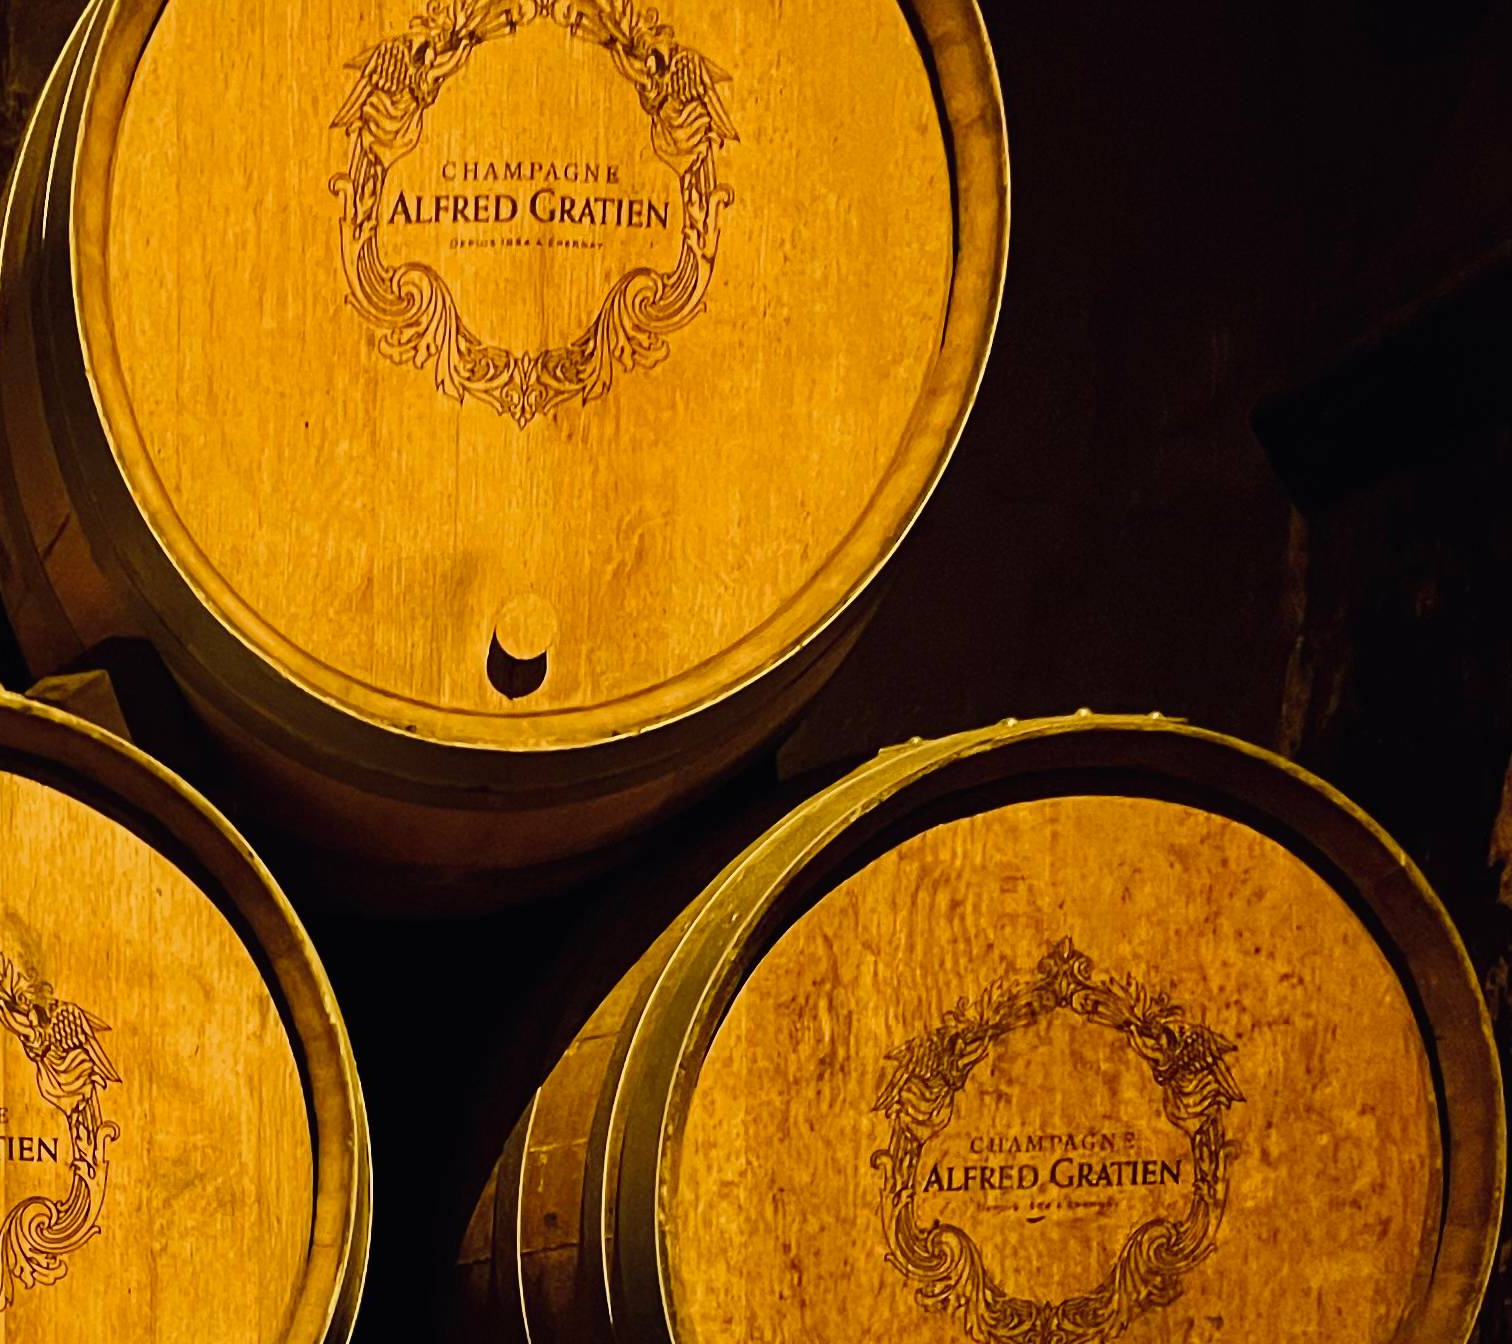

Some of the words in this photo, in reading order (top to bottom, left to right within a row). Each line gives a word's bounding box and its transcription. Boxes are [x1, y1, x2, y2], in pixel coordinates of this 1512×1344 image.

[441, 160, 621, 184] CHAMPAGNE
[387, 190, 519, 226] ALFRED
[529, 188, 670, 229] GRATIEN
[969, 1131, 1137, 1155] CHAMPAGNE
[922, 1162, 1039, 1193] ALFRED
[1049, 1157, 1183, 1188] GRATIEN
